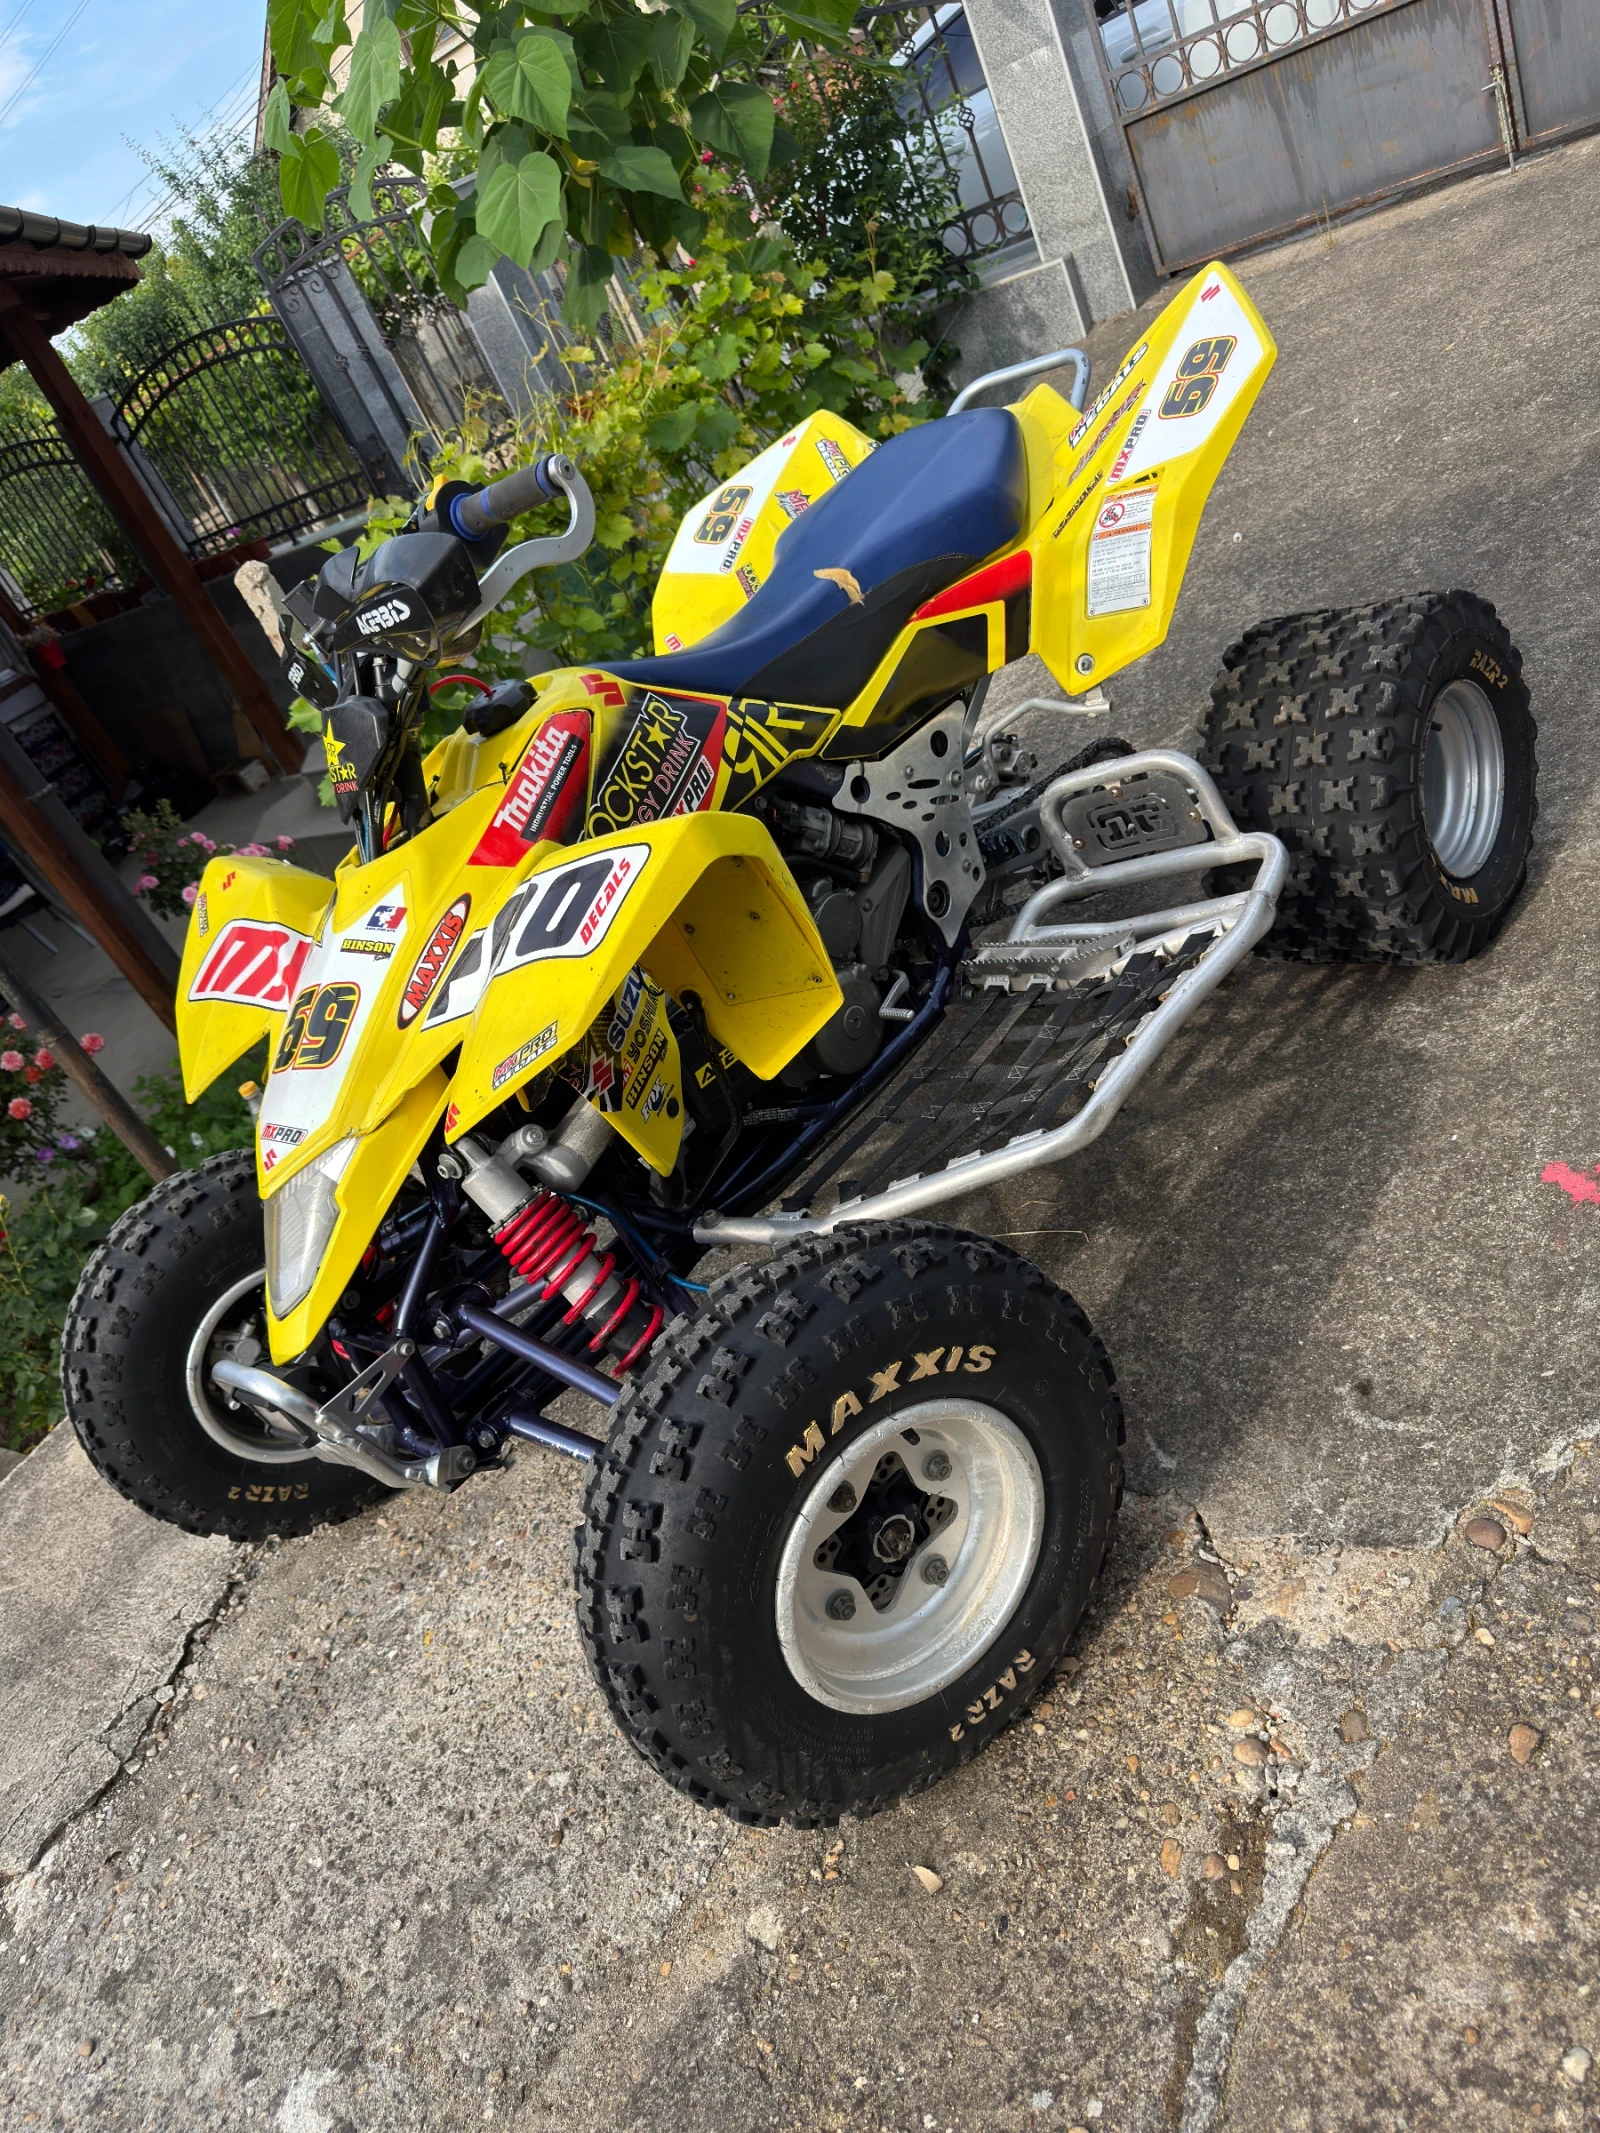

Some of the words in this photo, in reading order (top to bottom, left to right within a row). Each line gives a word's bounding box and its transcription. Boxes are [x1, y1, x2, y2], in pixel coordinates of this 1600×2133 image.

[550, 762, 568, 791] POWER
[562, 743, 578, 768] TOOLS
[654, 732, 695, 795] DRINK
[579, 857, 632, 946] DECALS
[340, 939, 396, 955] HINSON
[405, 911, 464, 1011] MAXXIS
[626, 1027, 667, 1110] HINSON
[641, 1073, 668, 1124] FOX
[785, 1344, 998, 1479] MAXXIS
